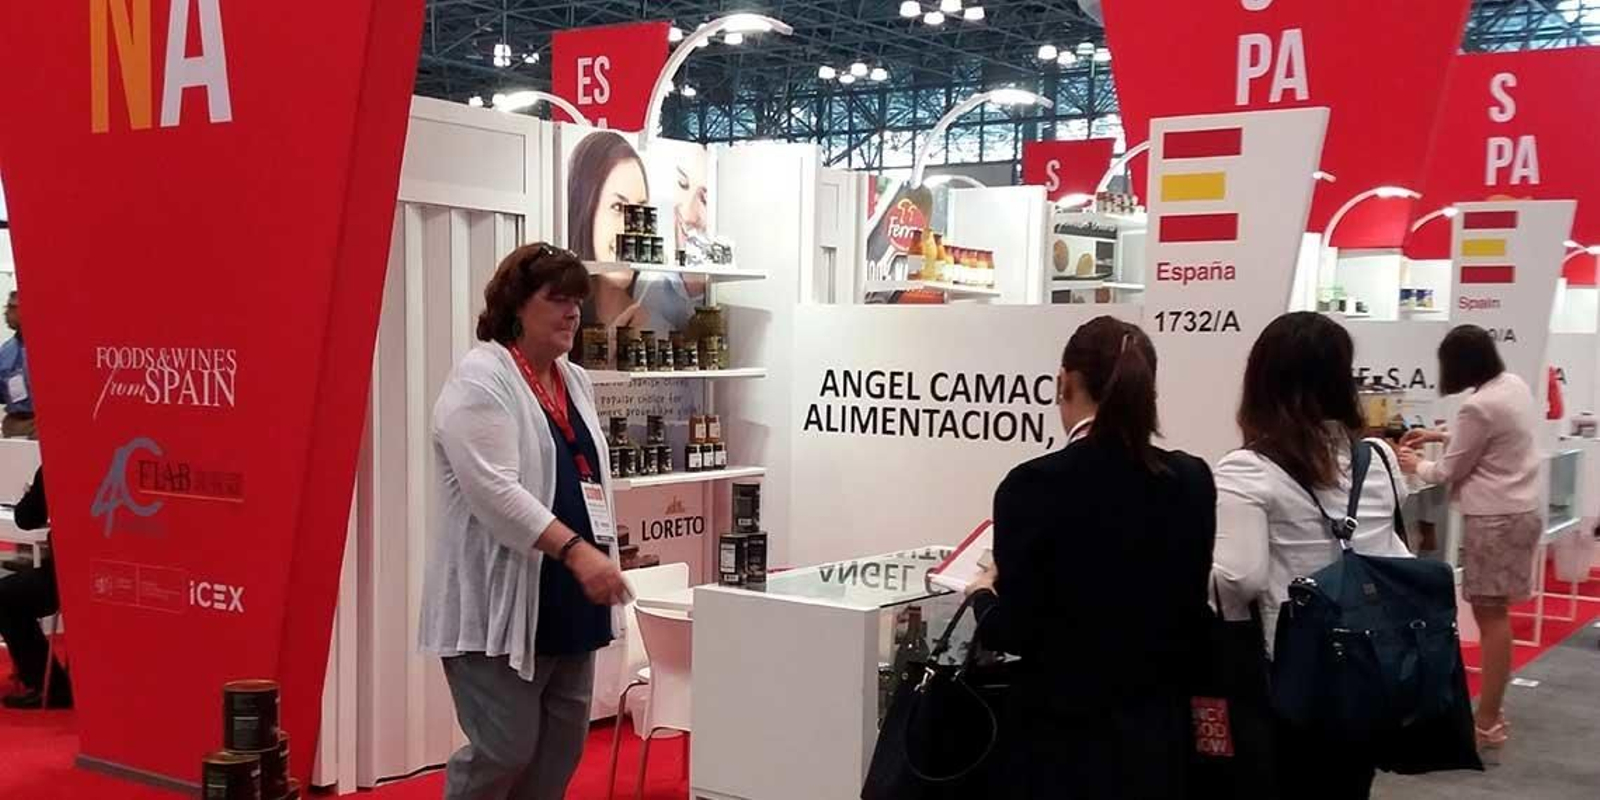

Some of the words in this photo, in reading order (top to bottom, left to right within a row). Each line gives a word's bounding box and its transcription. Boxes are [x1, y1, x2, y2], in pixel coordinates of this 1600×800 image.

[577, 55, 611, 105] ES
[1235, 28, 1310, 106] PA
[1485, 134, 1541, 187] PA
[1156, 261, 1236, 286] España
[1154, 309, 1242, 333] 1732/A
[1459, 295, 1501, 312] Spain
[96, 346, 238, 373] FOODS&WINES
[145, 366, 236, 408] SPAIN
[819, 369, 921, 401] ANGEL
[929, 371, 1061, 406] CAMAC
[803, 403, 1055, 450] ALIMENTACION,
[641, 515, 705, 542] LORETO
